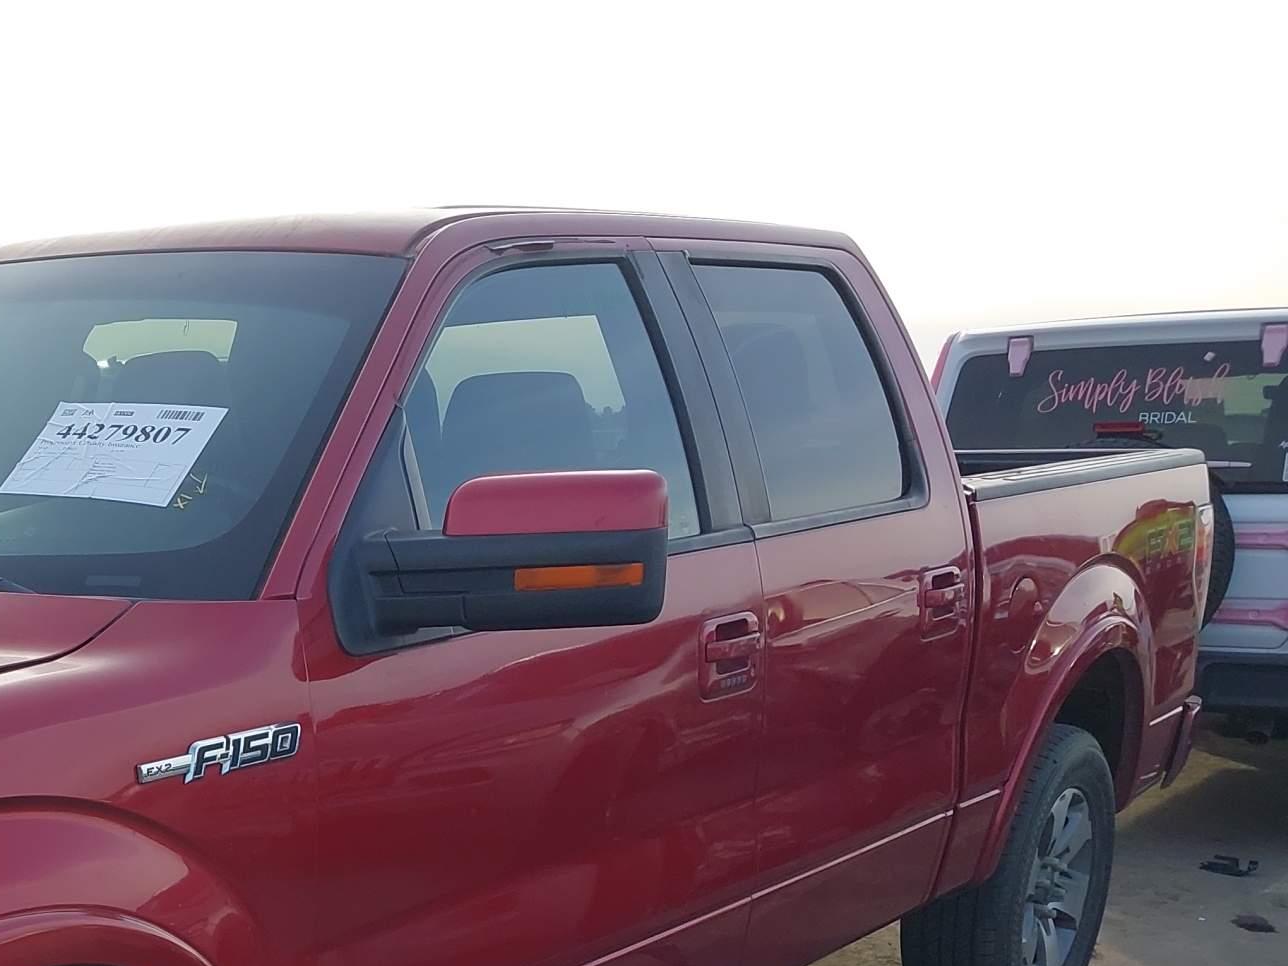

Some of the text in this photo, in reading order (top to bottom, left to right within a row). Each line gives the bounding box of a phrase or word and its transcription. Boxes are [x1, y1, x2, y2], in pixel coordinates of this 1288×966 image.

[1037, 369, 1141, 414] Simply
[56, 422, 192, 445] 44279807
[1139, 411, 1197, 424] BRIDAL
[184, 724, 302, 784] F-150
